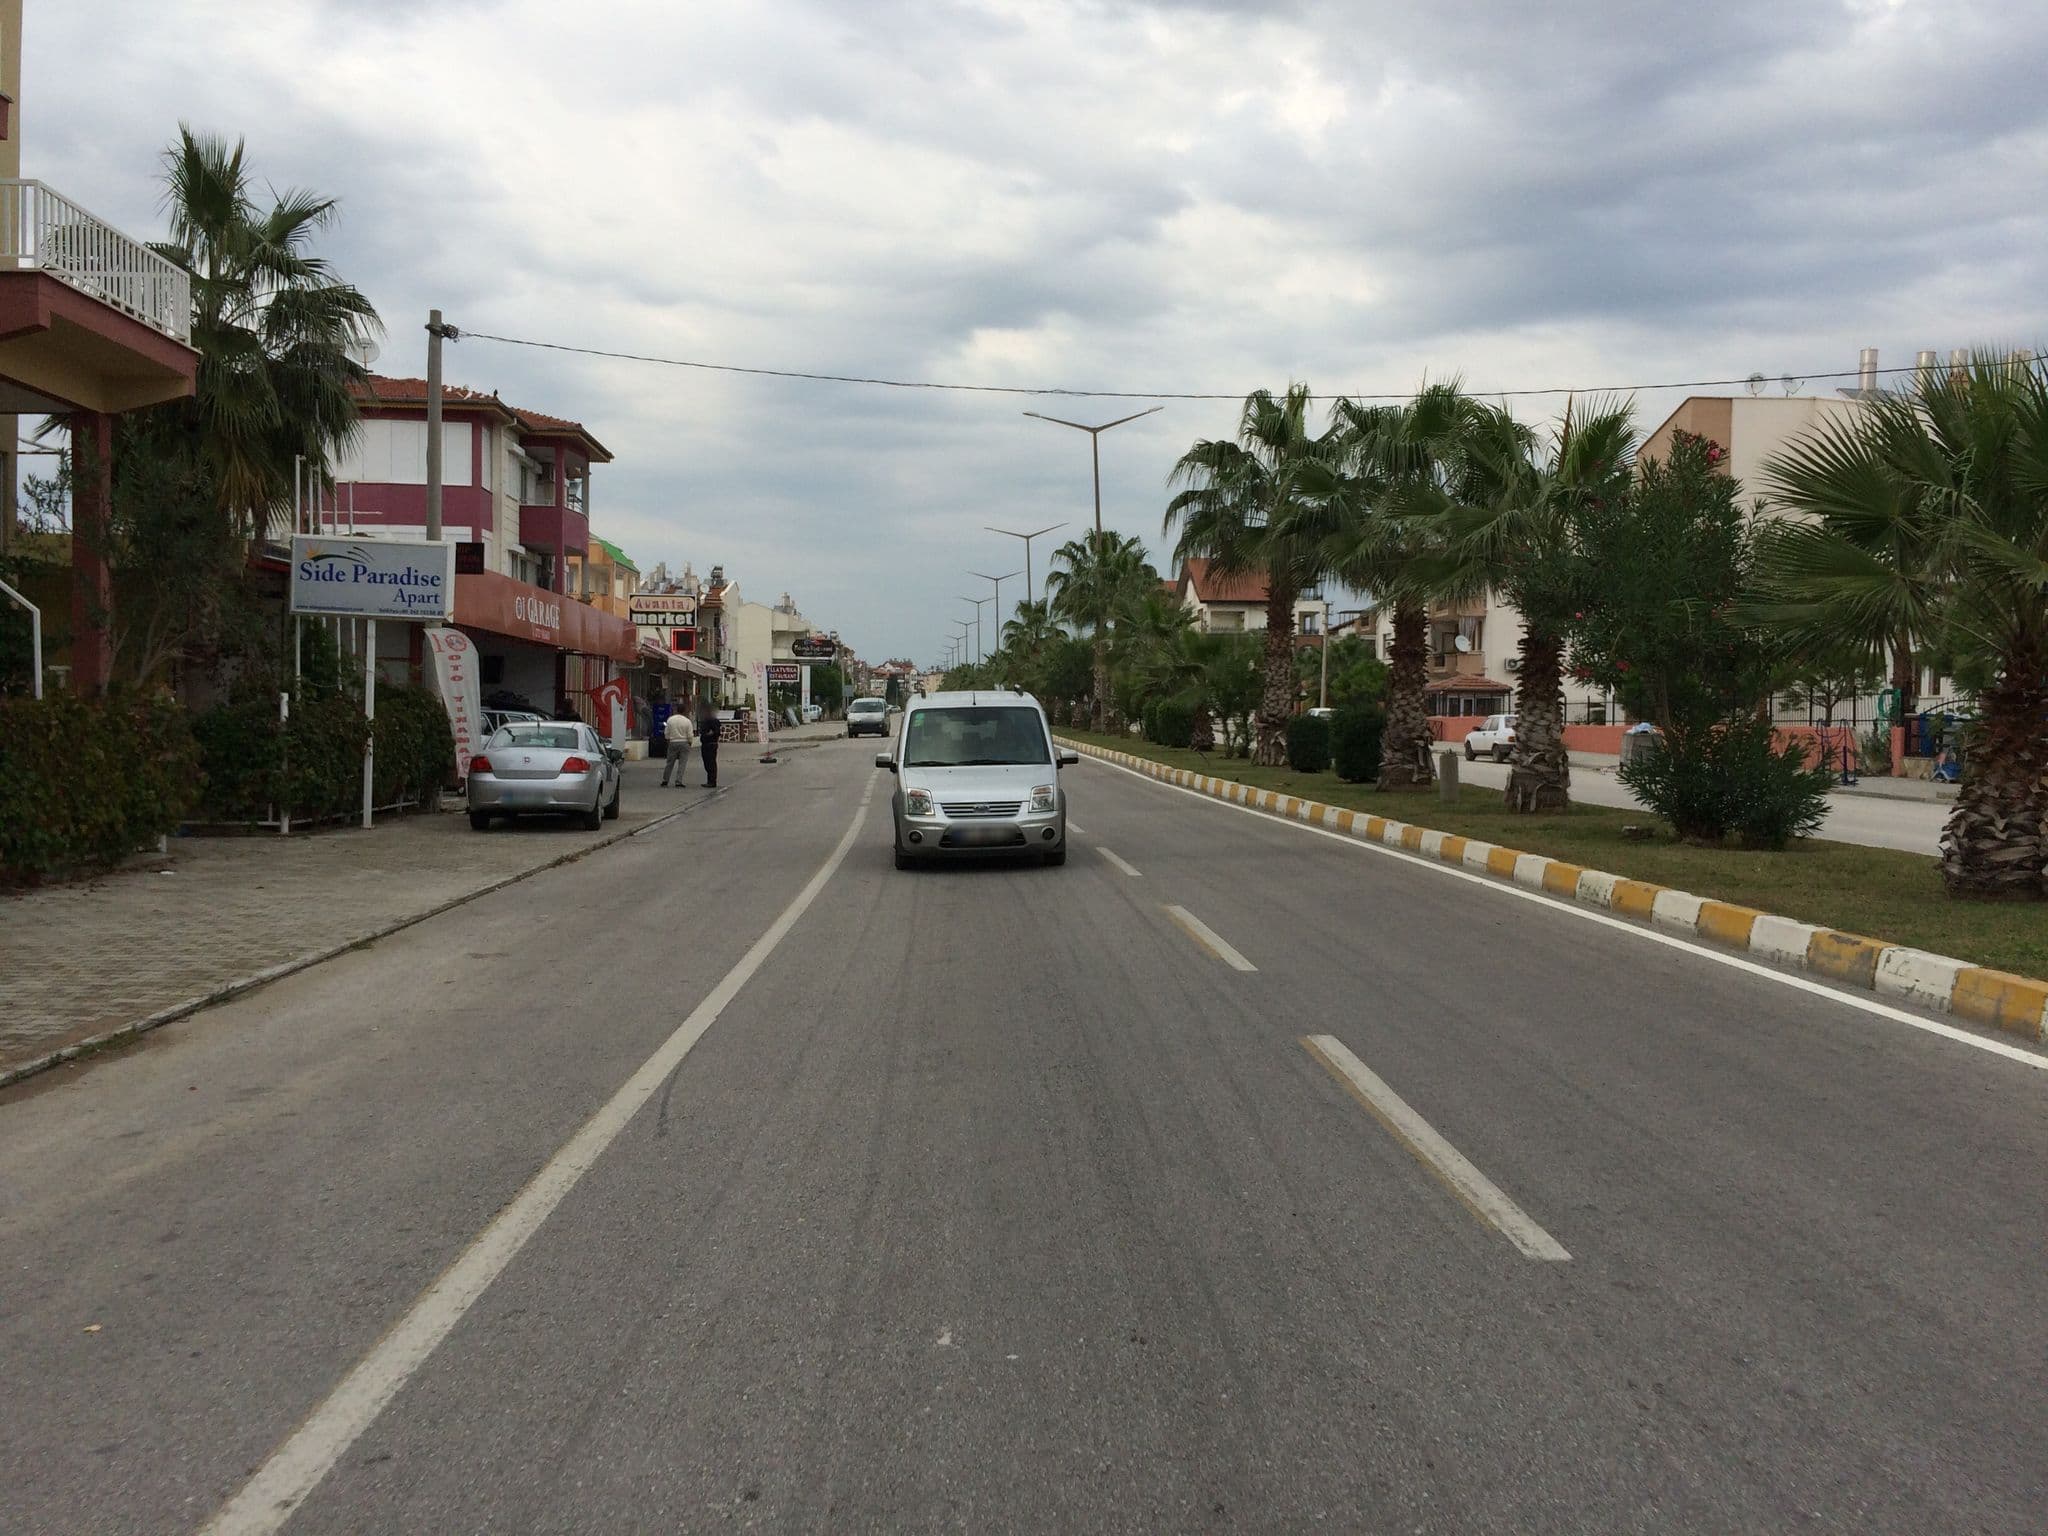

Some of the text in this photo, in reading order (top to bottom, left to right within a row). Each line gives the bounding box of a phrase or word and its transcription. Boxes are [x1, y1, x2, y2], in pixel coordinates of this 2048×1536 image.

[300, 561, 441, 587] Side Paradise
[393, 588, 440, 608] Apart
[528, 597, 560, 630] GARAGE
[632, 612, 693, 625] market
